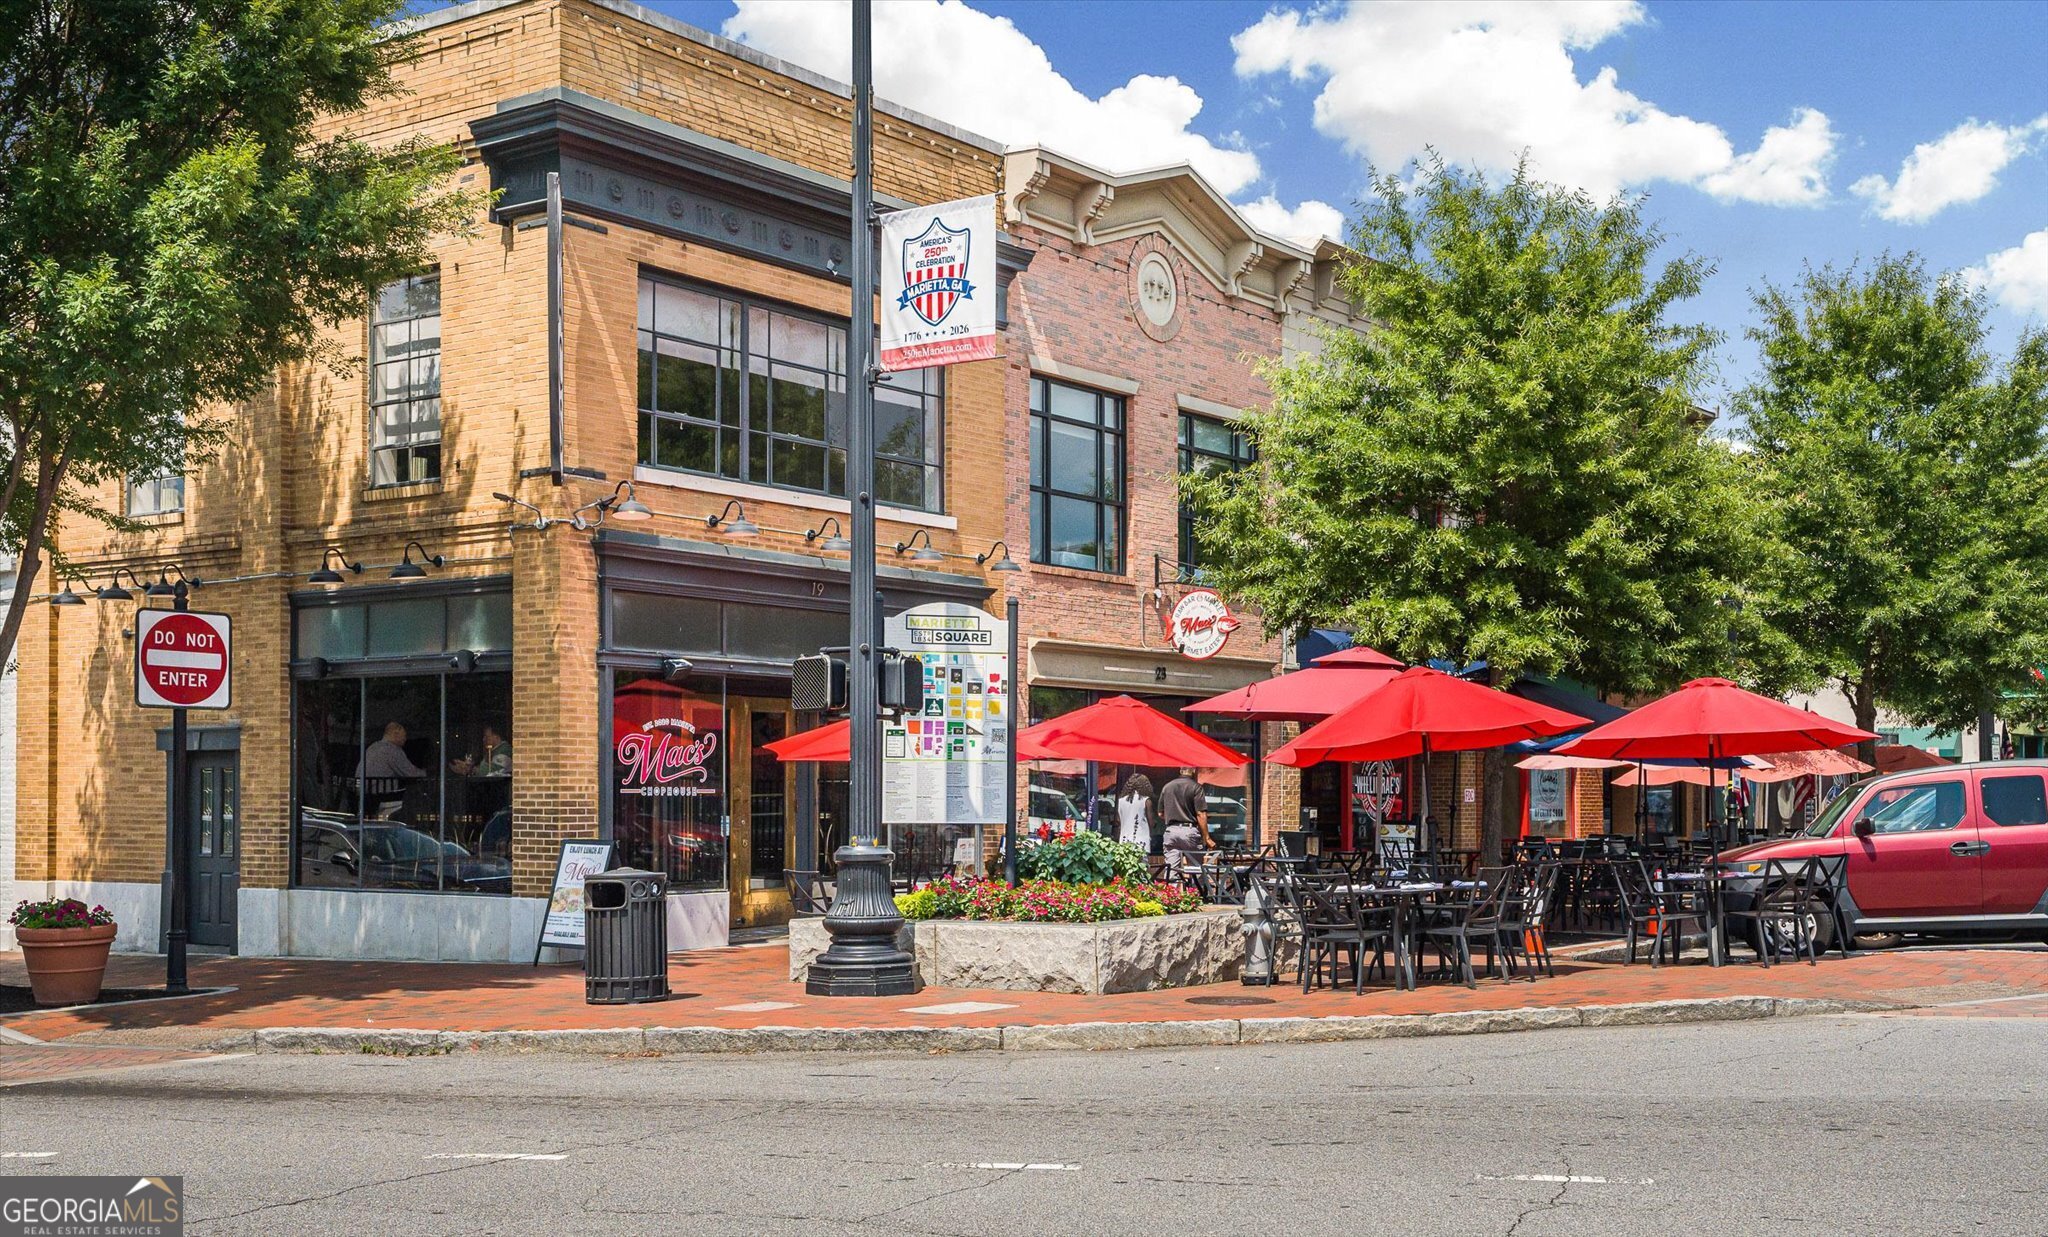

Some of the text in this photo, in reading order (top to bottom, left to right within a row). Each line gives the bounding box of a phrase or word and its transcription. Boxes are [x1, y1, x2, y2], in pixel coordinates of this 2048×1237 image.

[920, 236, 952, 248] AMERICA'S
[924, 246, 948, 258] 250th
[915, 255, 955, 268] CELEBRATION
[907, 279, 963, 298] MARIETTA, GA
[904, 324, 969, 342] 1776 2026
[903, 343, 972, 358] 250inMarietta.com
[812, 582, 824, 597] 19
[909, 617, 976, 629] MARIETTA
[154, 630, 215, 648] DO NOT
[935, 632, 988, 643] SQUARE
[159, 671, 207, 688] ENTER
[1156, 666, 1167, 680] 23
[618, 733, 717, 785] Mac's
[640, 786, 698, 797] CHOPHOUSE
[597, 846, 604, 855] AT
